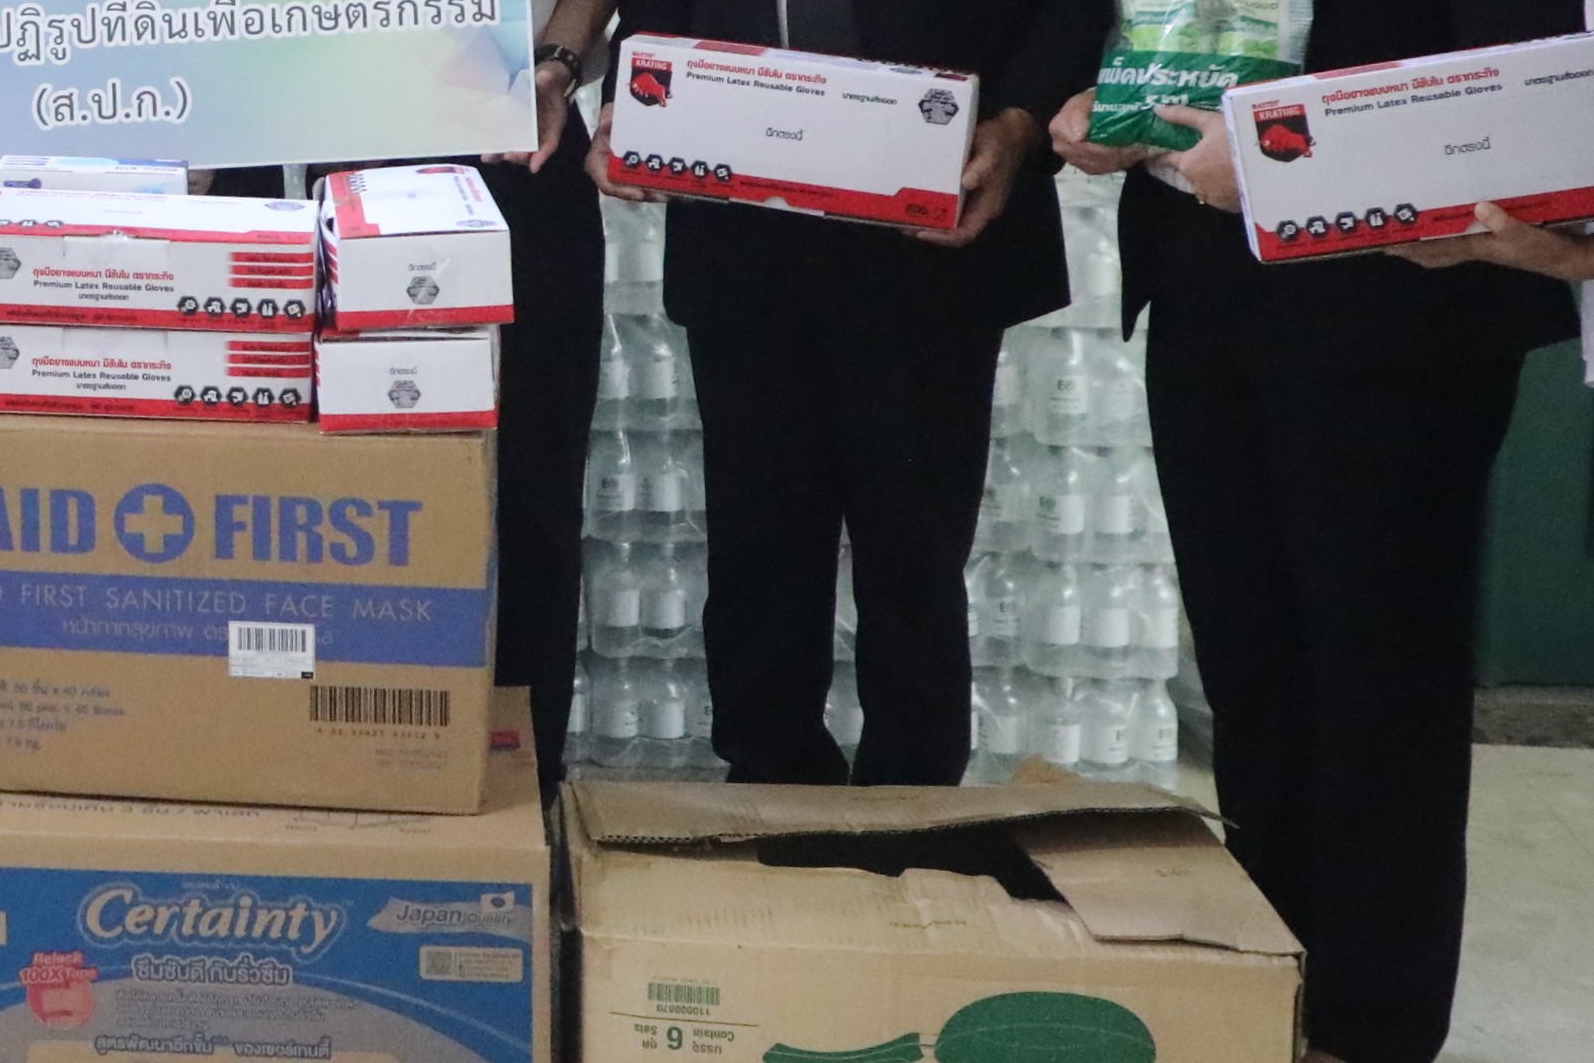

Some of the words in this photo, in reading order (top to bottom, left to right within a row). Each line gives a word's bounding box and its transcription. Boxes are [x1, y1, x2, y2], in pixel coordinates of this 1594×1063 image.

[635, 59, 668, 70] KRATING
[686, 72, 724, 83] Premium
[727, 77, 750, 86] Latex
[754, 80, 793, 91] Reusable
[796, 86, 825, 96] Gloves
[36, 80, 188, 125] (ส.ป.ก.)
[1324, 101, 1374, 117] Premium
[1378, 98, 1407, 110] Latex
[1411, 90, 1461, 103] Reusable
[1465, 82, 1502, 96] Gloves
[1259, 105, 1300, 121] KRATING
[103, 283, 142, 291] Reusable
[145, 284, 174, 292] Gloves
[32, 370, 71, 378] Premium
[73, 371, 96, 379] Latex
[100, 372, 139, 381] Reusable
[142, 373, 171, 382] Gloves
[215, 494, 422, 566] FIRST
[21, 584, 87, 608] FIRST
[107, 587, 246, 614] SANITIZED
[266, 594, 334, 619] FACE
[353, 598, 432, 622] MASK
[86, 889, 338, 954] Certainty
[396, 905, 462, 926] Japan
[667, 1026, 683, 1050] 6
[693, 1028, 735, 1042] Contain
